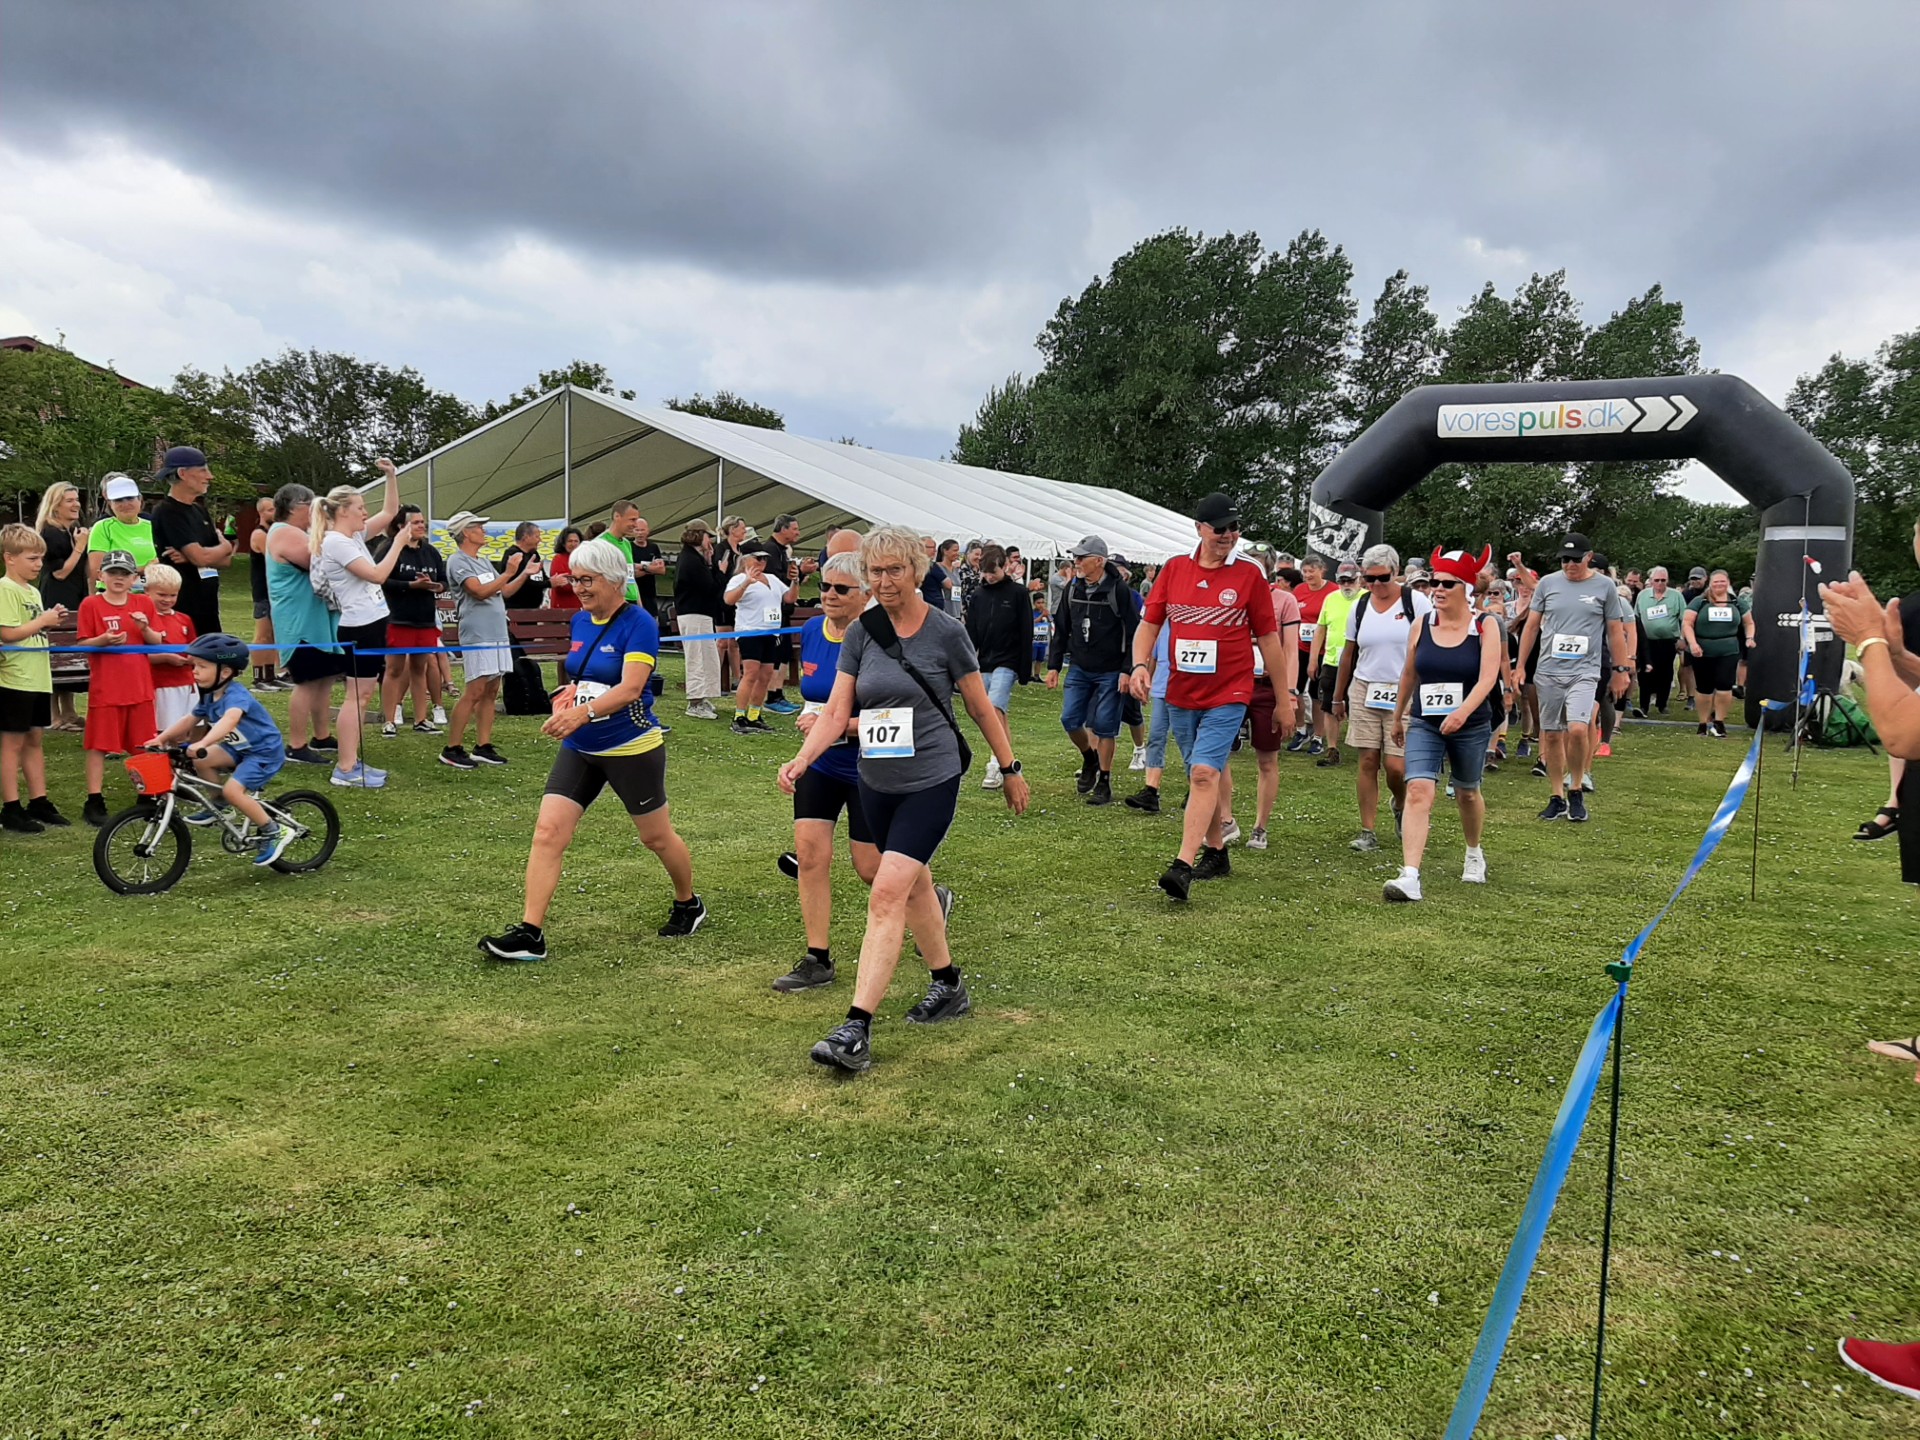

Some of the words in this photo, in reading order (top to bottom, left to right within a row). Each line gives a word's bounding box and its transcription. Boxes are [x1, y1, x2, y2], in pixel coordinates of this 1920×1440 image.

[1443, 402, 1625, 436] vorespuls.dk
[1558, 642, 1582, 653] 227
[1181, 650, 1208, 664] 277
[1373, 690, 1398, 703] 242
[1426, 694, 1454, 706] 278
[866, 725, 901, 743] 107
